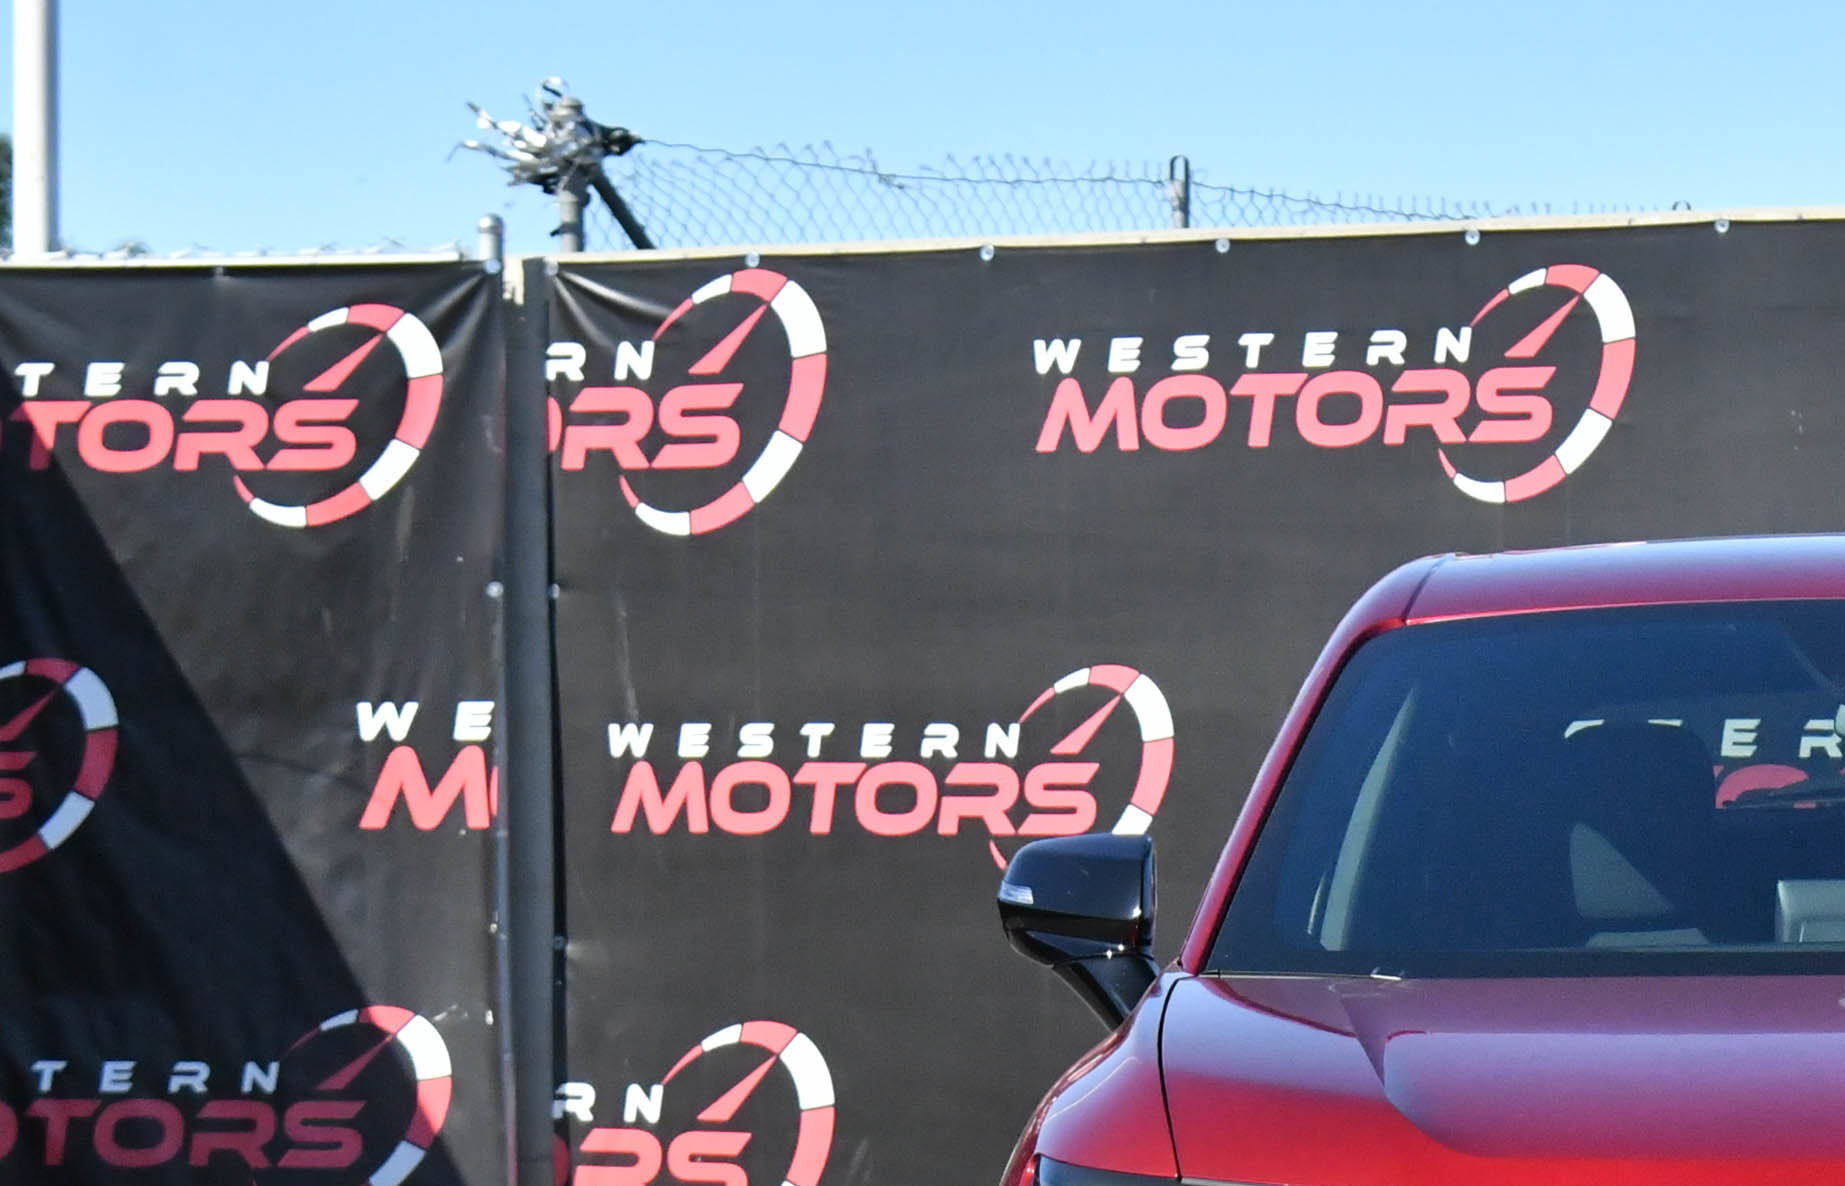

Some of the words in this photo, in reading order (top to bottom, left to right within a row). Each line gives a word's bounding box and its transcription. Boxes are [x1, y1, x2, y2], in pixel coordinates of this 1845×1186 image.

[545, 340, 655, 381] RN
[1033, 326, 1473, 375] WESTERN
[14, 361, 270, 397] TERN
[547, 382, 745, 473] RS
[1036, 366, 1558, 452] MOTORS
[356, 701, 496, 742] WE
[607, 722, 1021, 759] WESTERN
[358, 744, 499, 831] M
[610, 761, 1100, 836] MOTORS
[30, 1060, 279, 1094] TERN
[552, 1081, 664, 1125] RN
[0, 1097, 364, 1168] TORS
